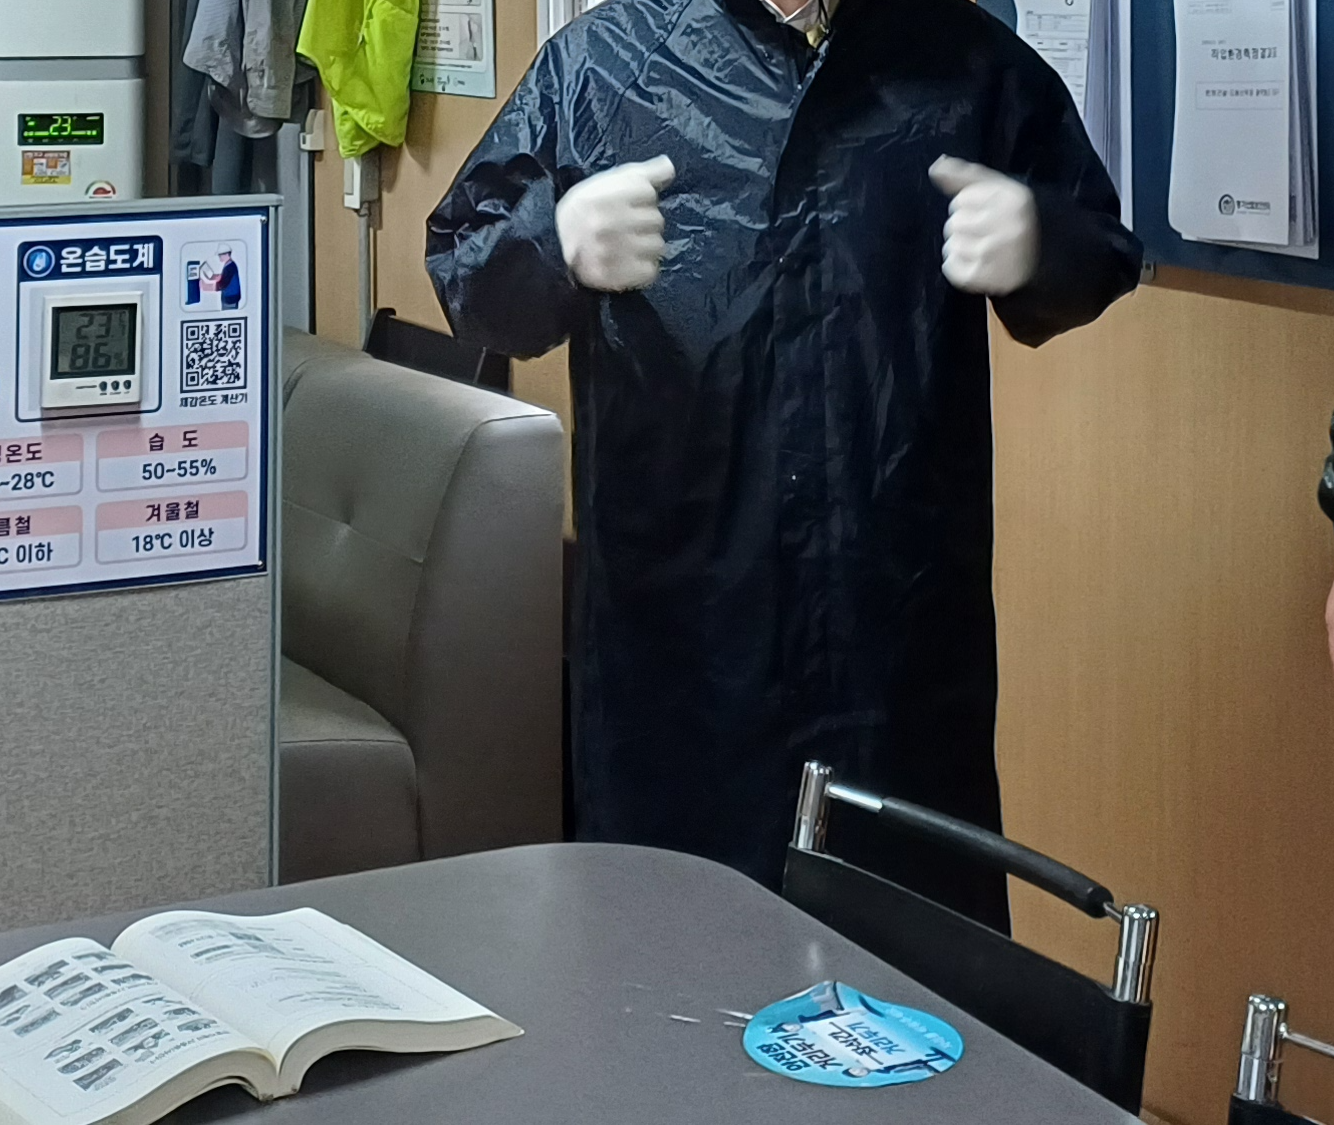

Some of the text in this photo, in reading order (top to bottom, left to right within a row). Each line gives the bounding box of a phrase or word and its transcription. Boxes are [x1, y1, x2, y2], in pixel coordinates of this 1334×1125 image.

[50, 116, 71, 135] 23
[60, 243, 154, 272] 온습도계
[141, 458, 217, 481] 50~55%
[145, 500, 200, 523] 겨울철
[179, 527, 215, 549] 이상
[16, 543, 53, 564] 이하
